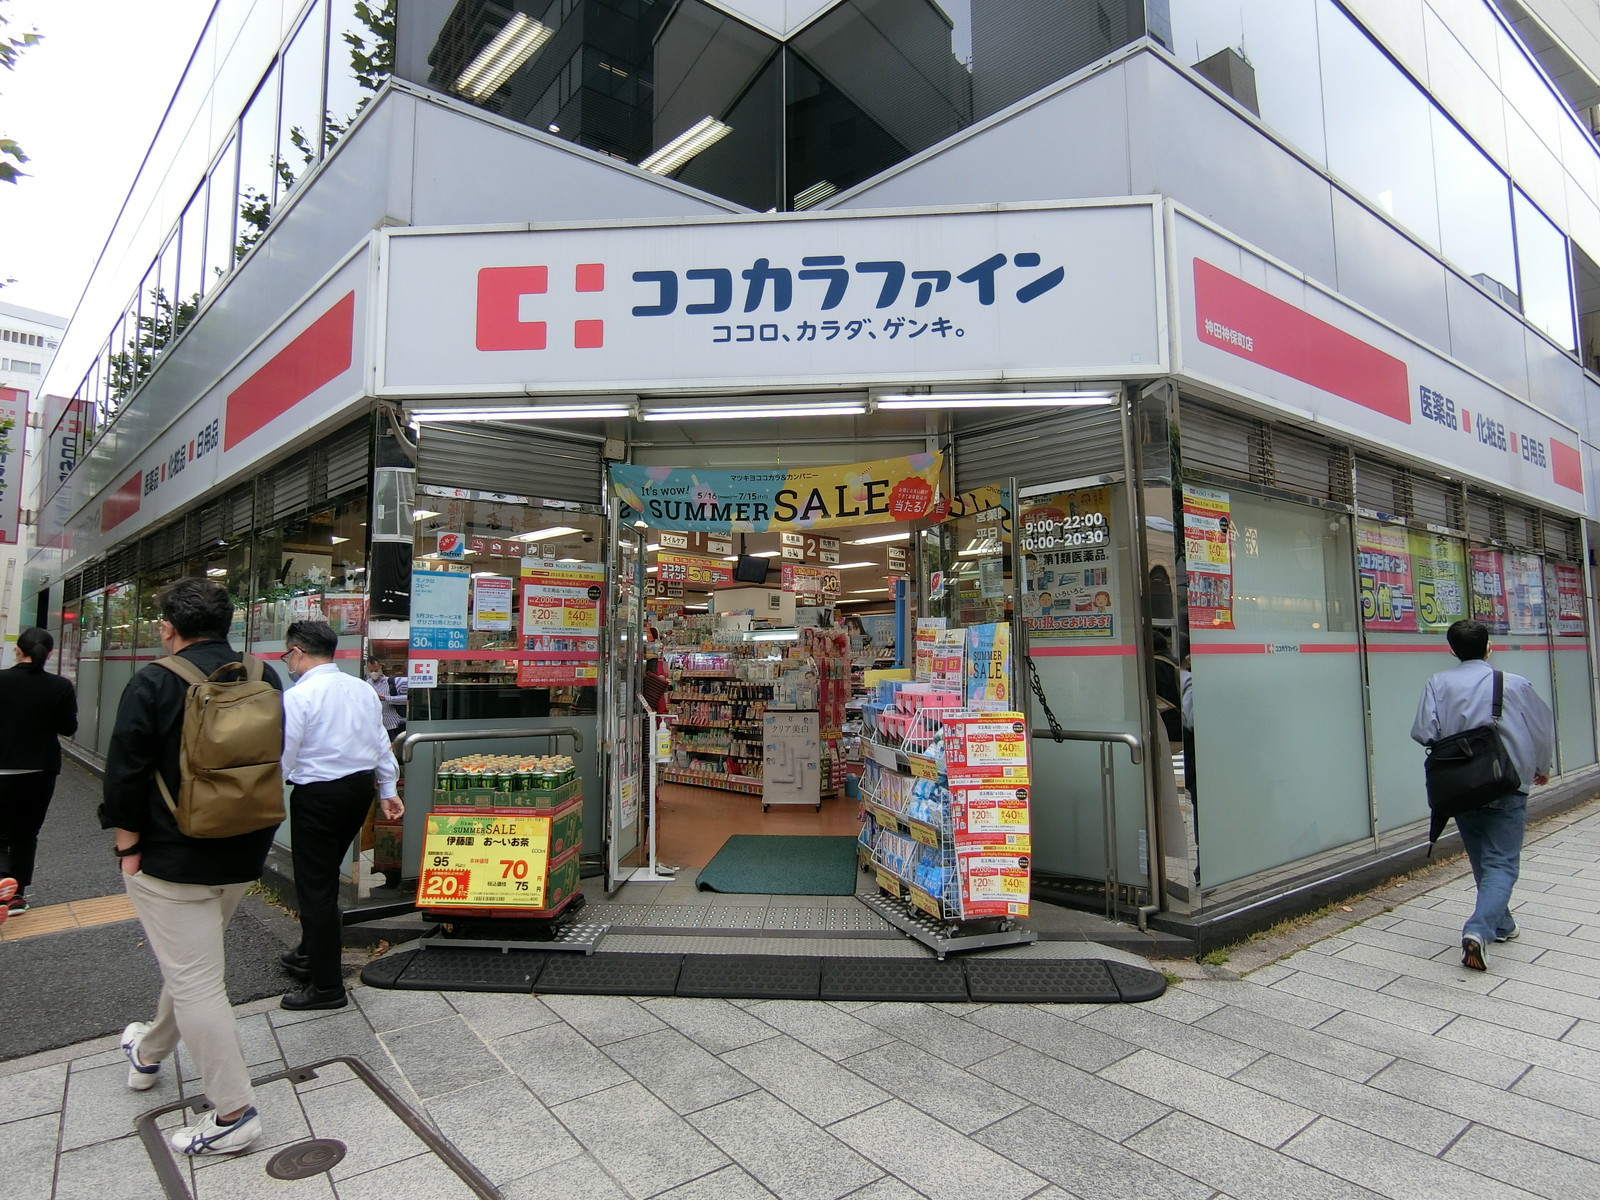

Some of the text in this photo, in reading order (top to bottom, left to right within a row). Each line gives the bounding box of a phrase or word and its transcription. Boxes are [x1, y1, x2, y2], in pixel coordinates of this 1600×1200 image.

[632, 251, 1065, 317] ココカラファイン
[712, 316, 966, 343] ココロ、カラダ、ゲンキ。
[1204, 318, 1254, 352] 神田神保町店
[1419, 384, 1458, 431] 医薬品
[197, 417, 219, 459] 日用品
[1476, 412, 1507, 453] 化粧品
[1520, 433, 1547, 469] 日用品
[168, 444, 186, 480] 化粧品
[144, 466, 159, 497] 医薬品
[641, 485, 690, 496] It's wow!
[649, 479, 890, 522] SUMMER SALE
[894, 499, 927, 513] 当たる!
[976, 527, 998, 540] 平日
[807, 539, 816, 556] 2
[662, 563, 686, 572] ココカラ
[662, 572, 686, 580] ポイント
[538, 609, 551, 620] 20
[572, 611, 586, 621] 40
[973, 650, 1002, 661] SUMMER
[973, 662, 1002, 679] SALE
[486, 824, 517, 835] SALE
[447, 836, 475, 846] 伊藤園
[433, 856, 449, 867] 95
[500, 860, 528, 879] 70
[426, 876, 458, 895] 20
[515, 882, 529, 890] 75
